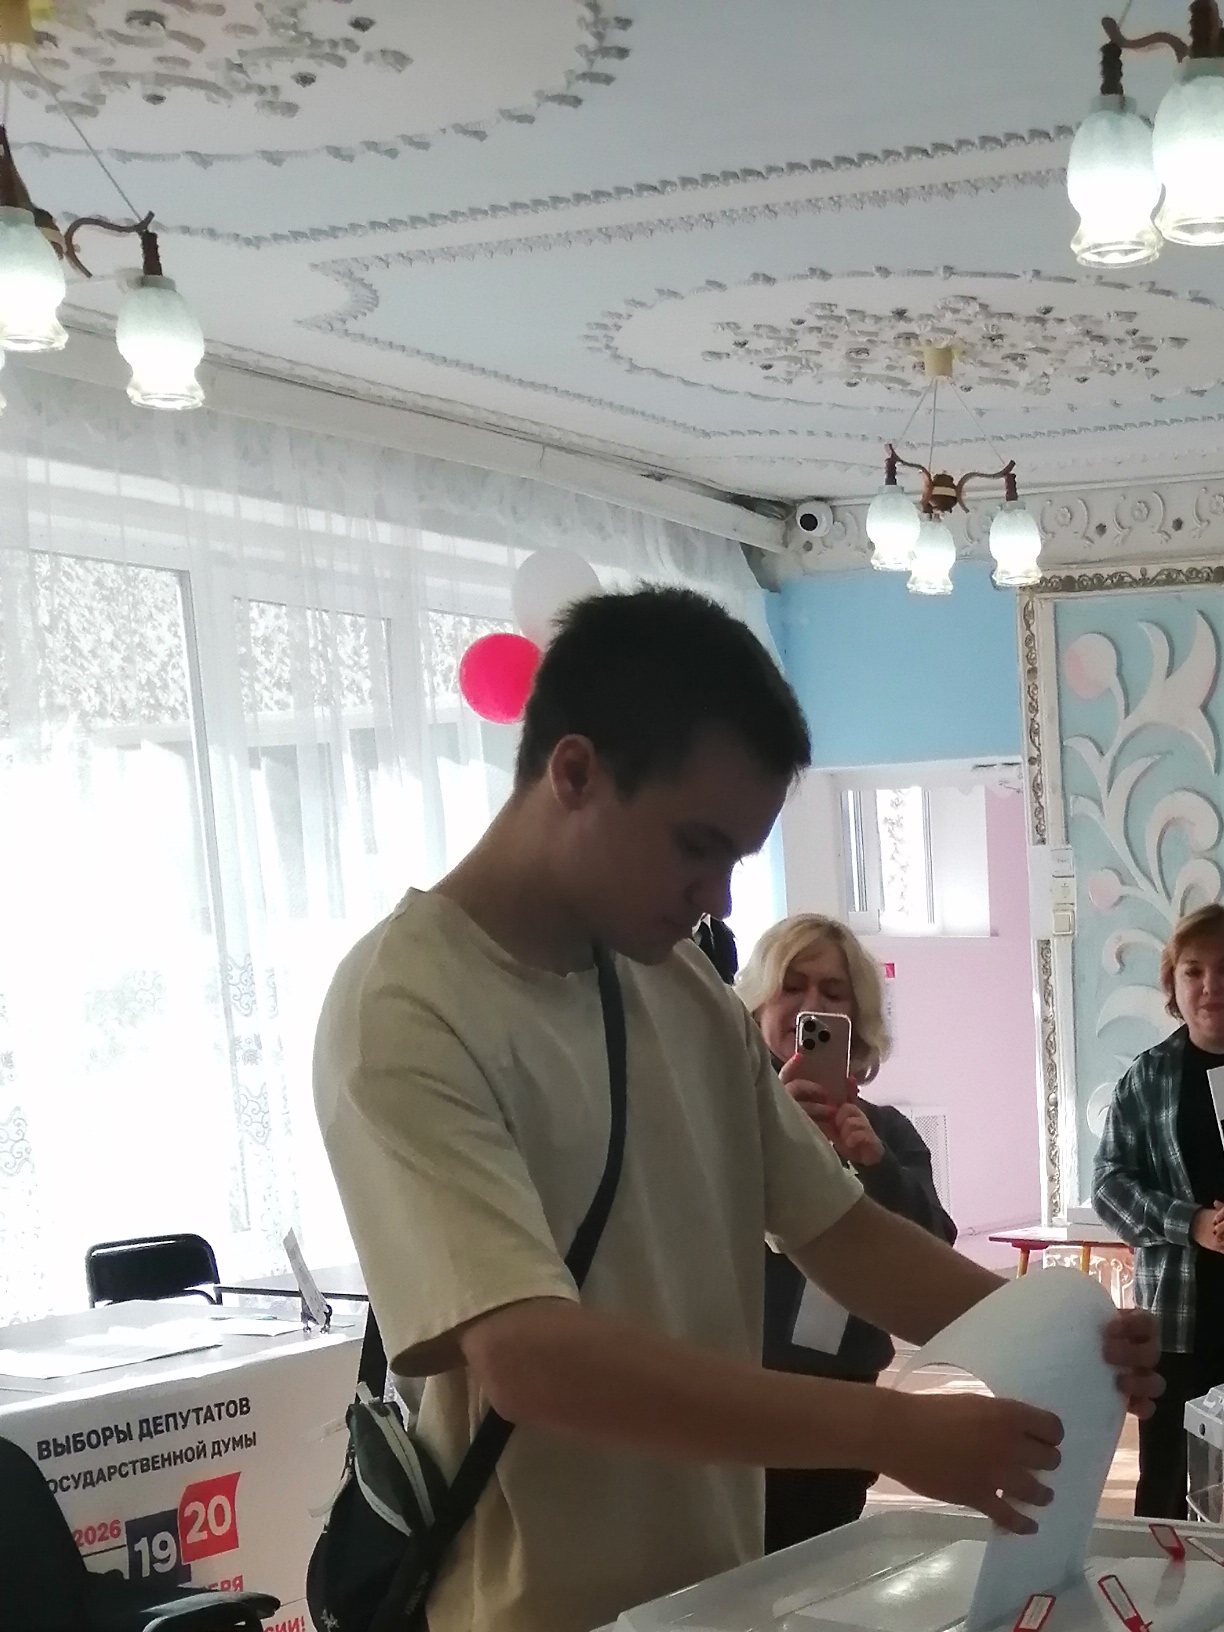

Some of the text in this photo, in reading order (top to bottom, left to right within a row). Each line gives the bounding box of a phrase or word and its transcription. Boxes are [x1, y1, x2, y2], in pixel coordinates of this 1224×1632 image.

[36, 1397, 251, 1460] ВЫБОРЫ ДЕПУТАТОВ
[46, 1431, 257, 1496] ОСУДАРСТВЕННОЙ ДУМЫ
[72, 1519, 121, 1548] 2026
[133, 1494, 232, 1578] 19 20
